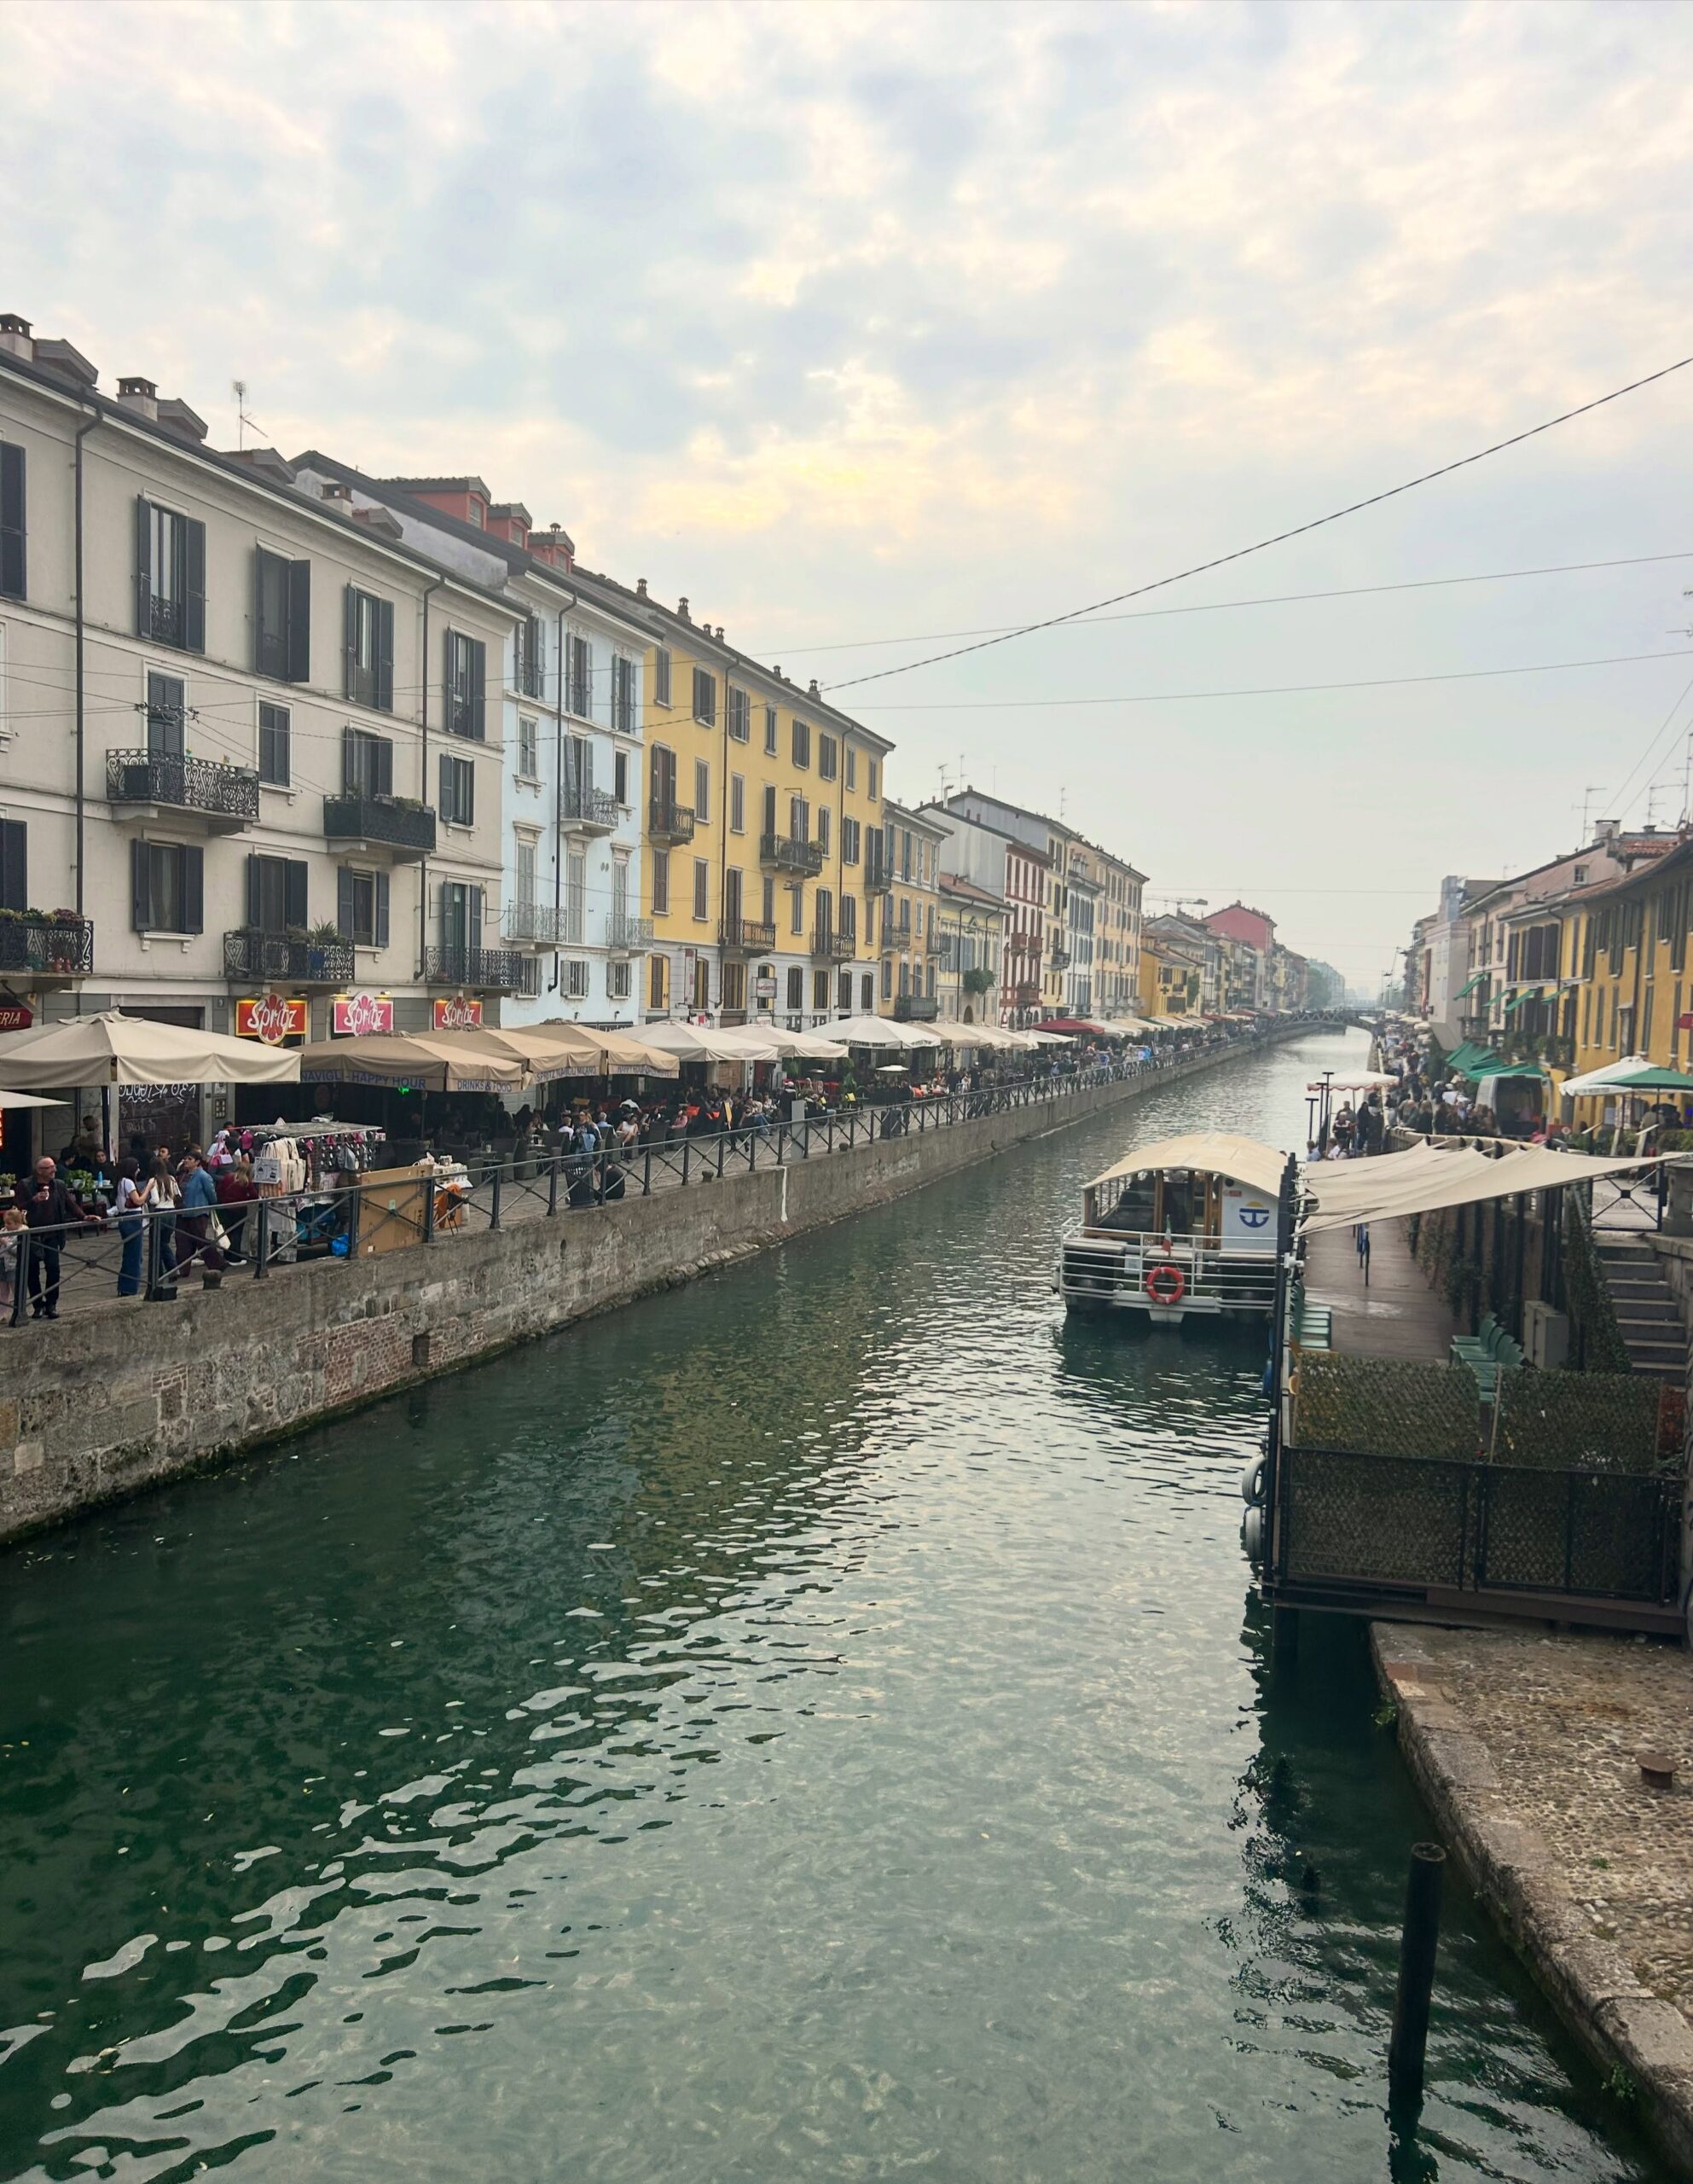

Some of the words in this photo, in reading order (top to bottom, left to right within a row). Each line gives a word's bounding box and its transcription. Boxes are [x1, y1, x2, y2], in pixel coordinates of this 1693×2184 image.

[247, 999, 298, 1035] Spritz
[344, 1000, 384, 1033] Spritz
[442, 1002, 476, 1026] Spritz
[352, 1071, 388, 1084] HAPPY
[392, 1075, 426, 1089] HOUR
[457, 1078, 484, 1090] DRINKS
